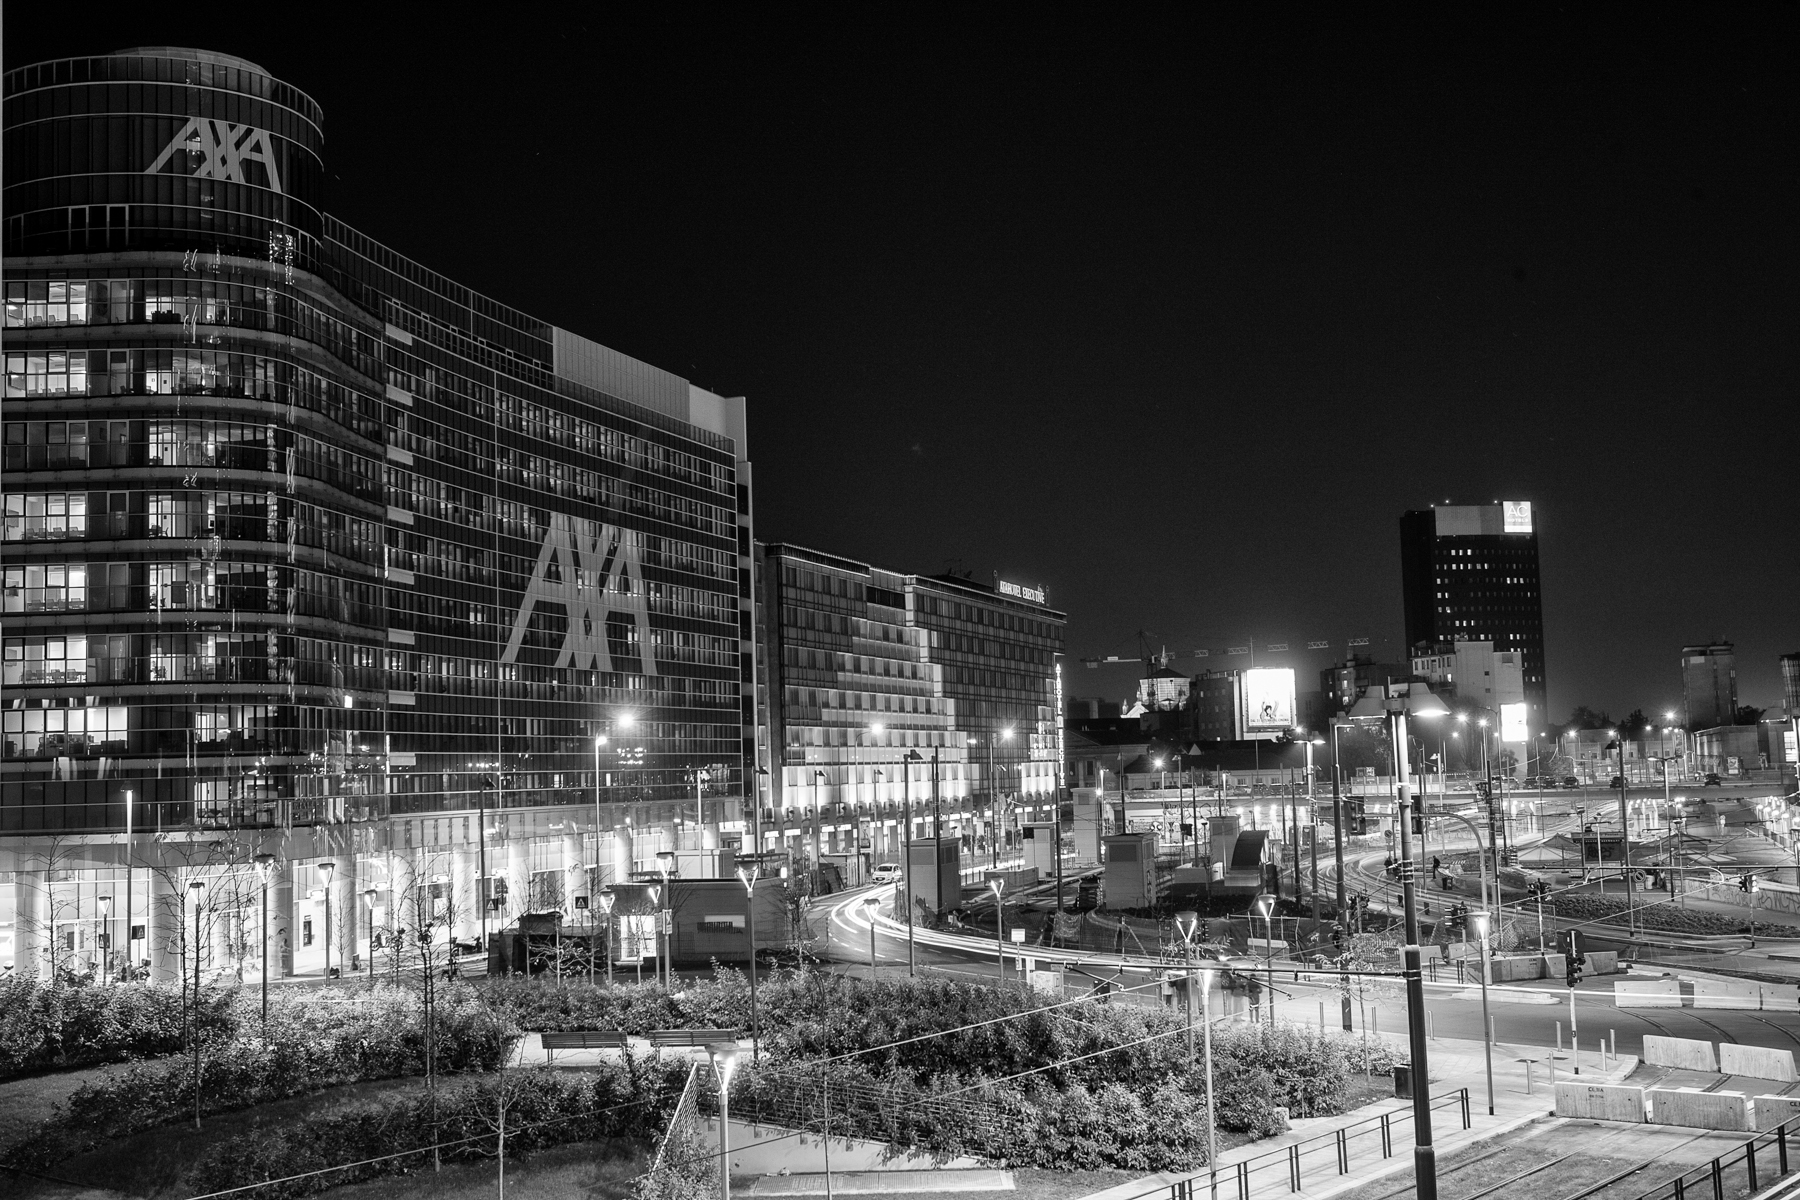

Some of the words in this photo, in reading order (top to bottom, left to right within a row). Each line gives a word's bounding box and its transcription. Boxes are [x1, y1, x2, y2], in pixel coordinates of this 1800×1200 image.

[145, 116, 282, 193] AXA
[1507, 505, 1528, 517] AC
[500, 511, 657, 677] AXA
[1022, 586, 1045, 604] EXECUTIVE
